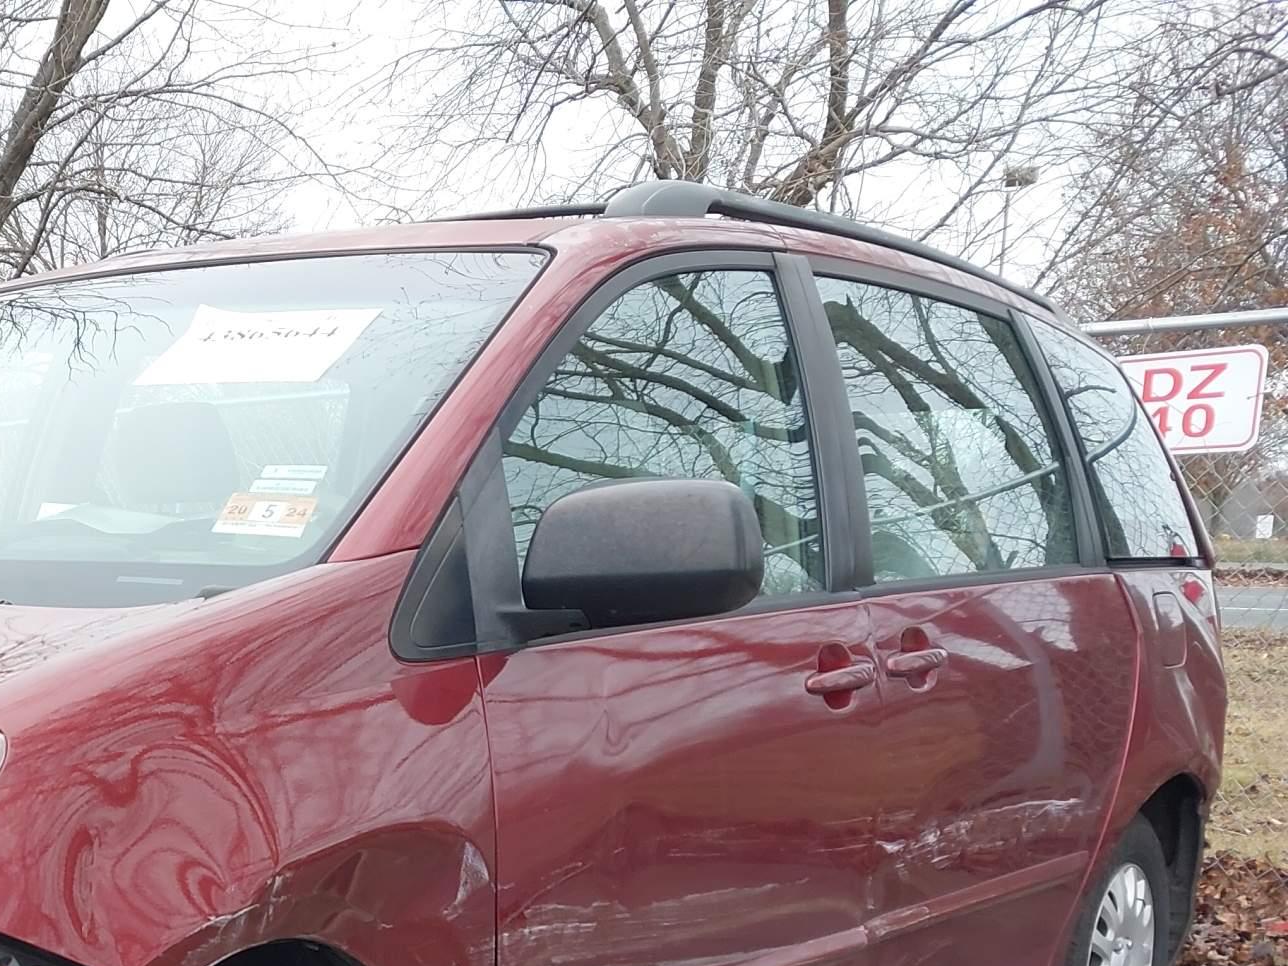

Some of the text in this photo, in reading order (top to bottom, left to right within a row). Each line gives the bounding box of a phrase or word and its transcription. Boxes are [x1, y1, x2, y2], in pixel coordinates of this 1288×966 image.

[1142, 363, 1228, 402] DZ
[227, 504, 309, 519] 20 5 24
